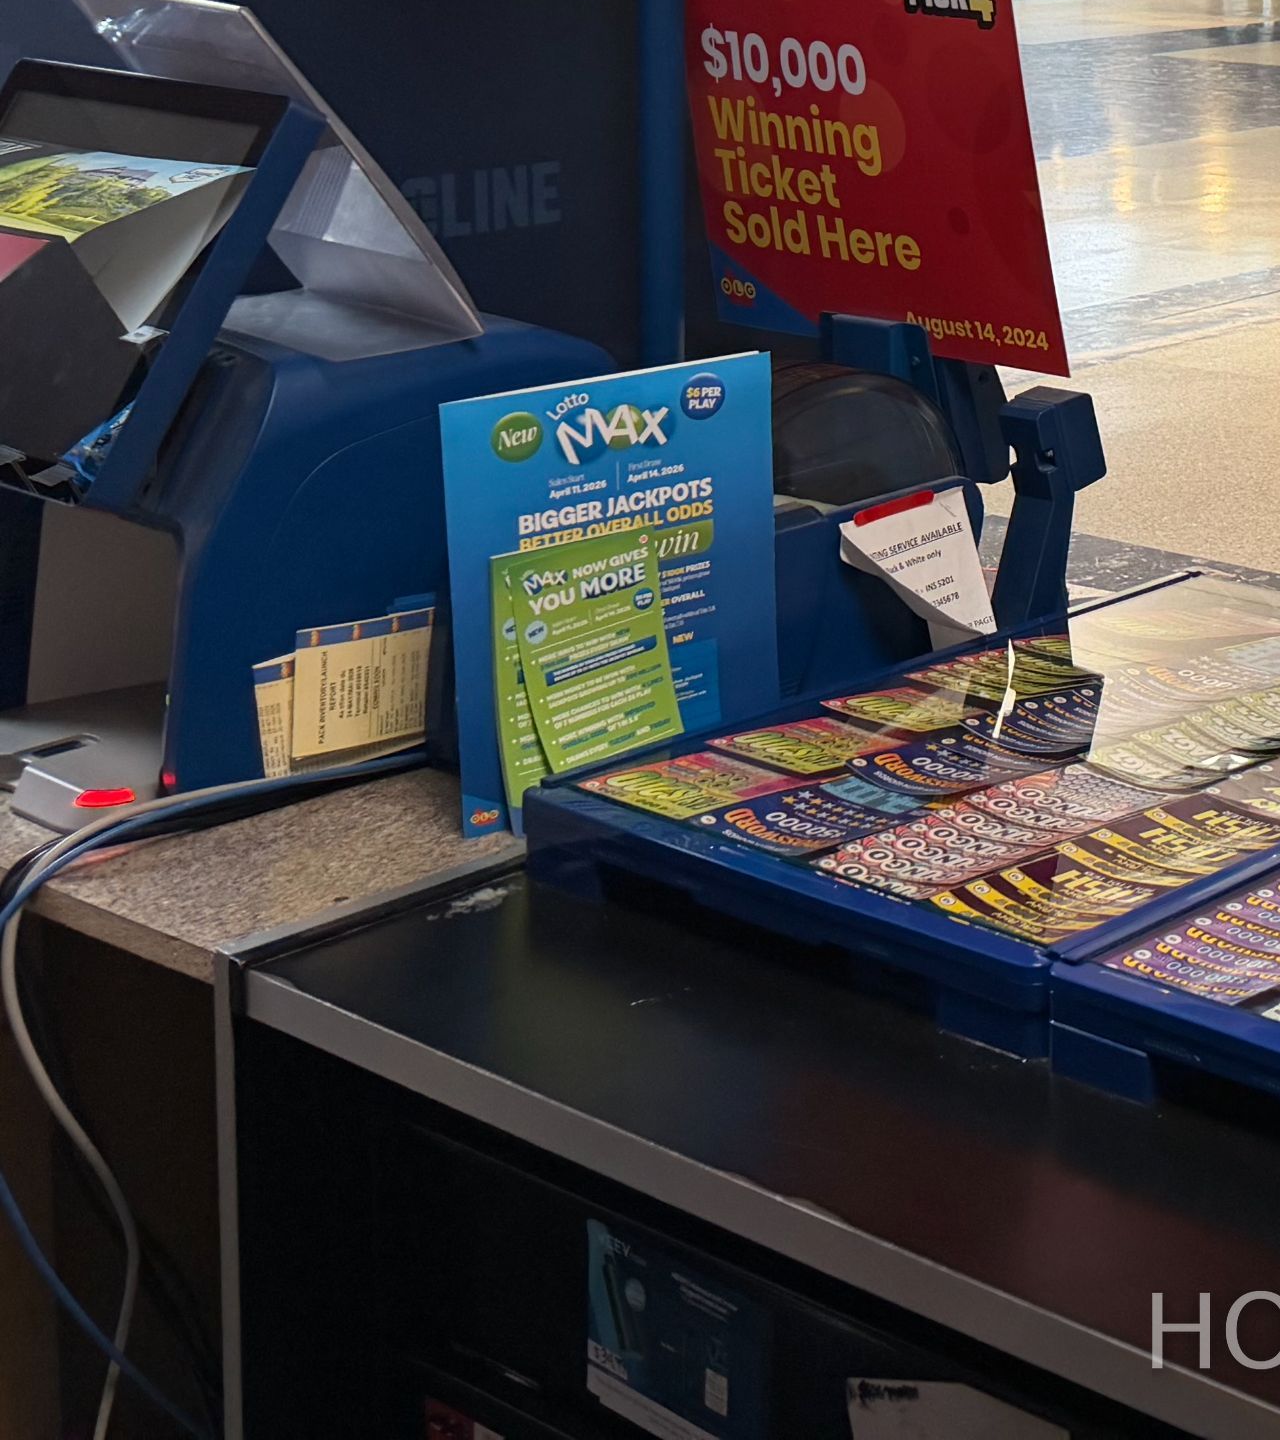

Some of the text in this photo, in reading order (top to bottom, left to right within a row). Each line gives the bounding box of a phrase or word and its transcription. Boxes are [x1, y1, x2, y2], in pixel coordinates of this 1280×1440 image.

[701, 23, 867, 97] $10,000
[707, 95, 882, 176] Winning
[714, 148, 841, 209] Ticket
[723, 201, 922, 271] Sold Here
[976, 320, 1001, 347] 14,
[1002, 324, 1049, 351] 2024
[546, 392, 590, 421] Lotto
[686, 386, 722, 399] $6 PER
[688, 397, 717, 410] PLAY
[498, 426, 538, 451] New
[556, 403, 669, 465] MAX
[627, 470, 648, 484] April
[661, 463, 685, 477] 2026
[518, 500, 603, 535] BIGGER
[606, 477, 713, 518] JACKPOTS
[549, 486, 571, 500] April
[519, 498, 714, 552] BETTER OVERALL ODDS
[889, 521, 963, 555] SERVICE AVAILABLE
[522, 546, 649, 596] MAX NOW GIVES
[528, 588, 575, 616] YOU
[580, 562, 647, 600] MORE
[670, 589, 706, 605] OVERALL
[672, 631, 694, 645] NEW
